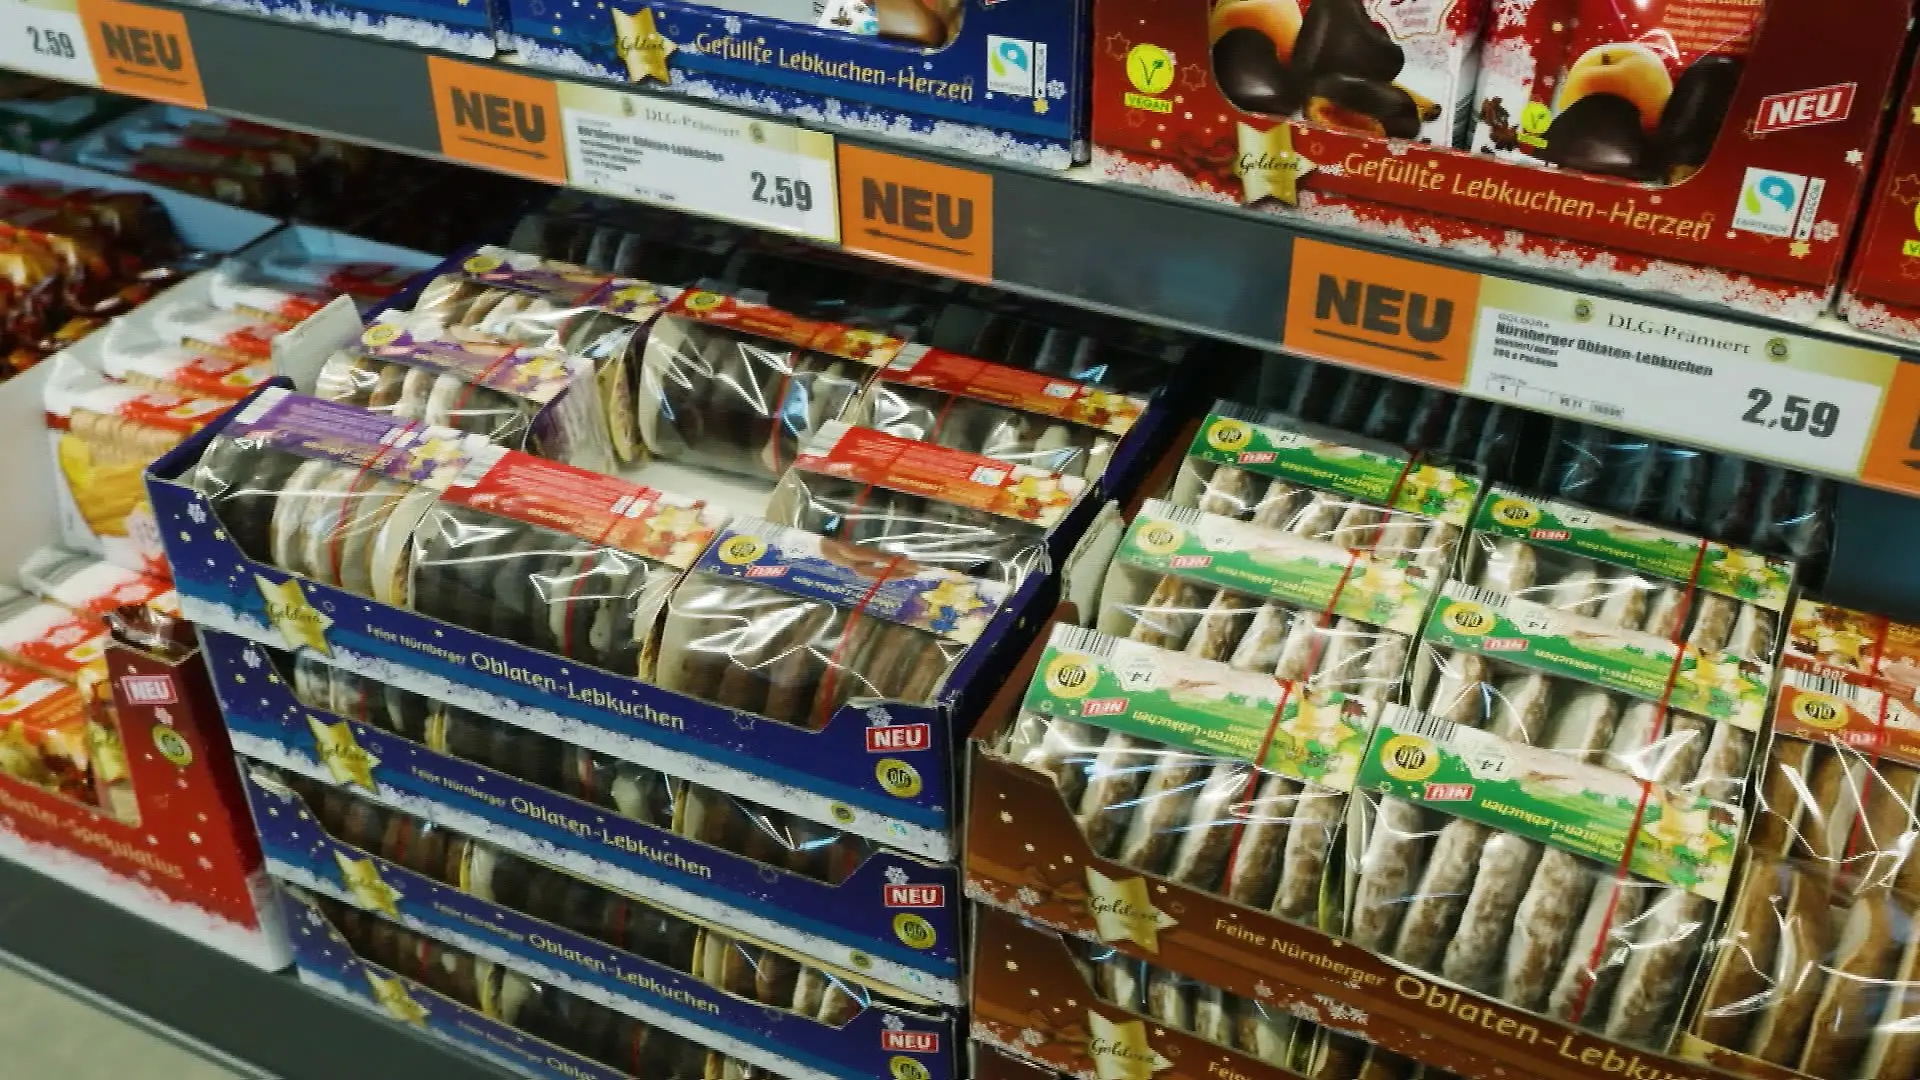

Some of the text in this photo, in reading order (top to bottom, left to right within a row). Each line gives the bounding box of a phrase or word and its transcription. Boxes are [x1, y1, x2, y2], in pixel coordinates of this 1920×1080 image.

[100, 21, 182, 71] NEU
[695, 33, 973, 102] Gefüllte Lebkuchen-Herzen
[451, 88, 546, 144] NEU
[1127, 95, 1171, 112] VEGAN
[1767, 90, 1843, 126] NEU
[751, 169, 813, 212] 2,59
[862, 176, 974, 240] NEU
[1344, 152, 1712, 241] Gefüllte Lebkuchen-Herzen
[1315, 273, 1454, 343] NEU
[1607, 312, 1751, 355] DLG-Prämiert
[1496, 321, 1714, 377] Nürnberger Oblaten-Lebkuchen
[1741, 386, 1839, 440] 2,59
[129, 679, 169, 701] NEU
[366, 623, 685, 732] Feine Nürnberger Oblaten-Lebkuchen
[874, 729, 922, 748] NEU
[1428, 785, 1470, 800] NEU
[511, 796, 712, 880] Oblaten-Lebkuchen
[891, 888, 937, 904] NEU
[528, 932, 720, 1016] Oblaten-Lebkuchen
[1214, 917, 1267, 948] Feine
[1271, 937, 1387, 988] Nürnberger
[889, 1033, 931, 1050] NEU
